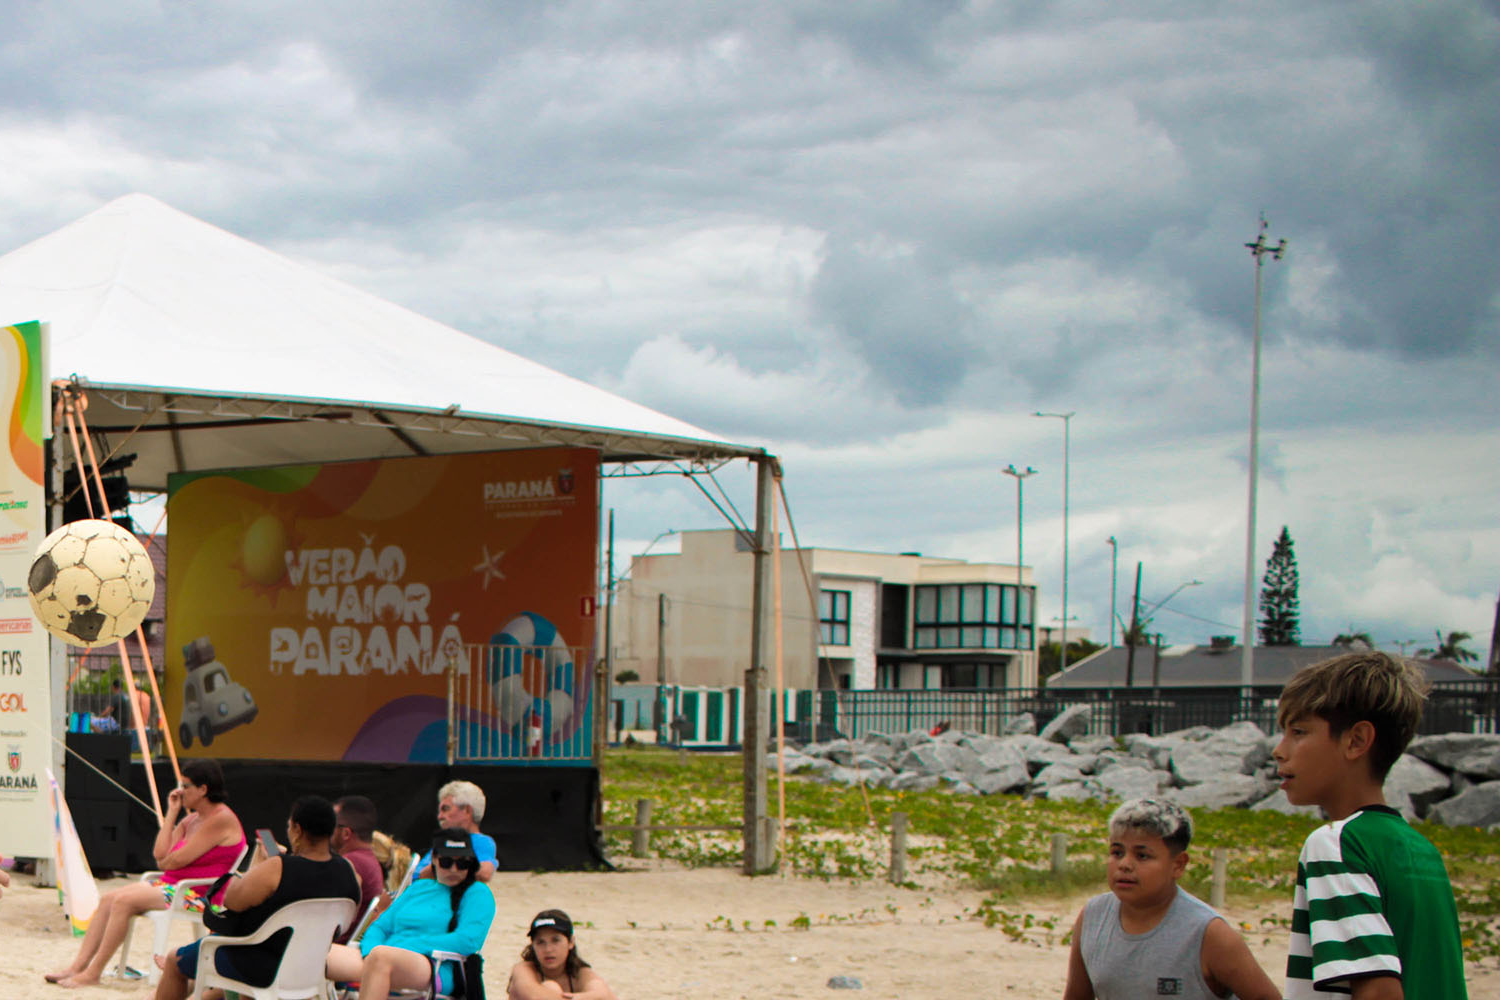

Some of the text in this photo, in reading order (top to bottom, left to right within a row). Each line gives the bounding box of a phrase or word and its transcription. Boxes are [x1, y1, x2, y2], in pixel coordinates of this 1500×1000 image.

[484, 476, 555, 499] PARANÁ
[284, 531, 407, 586] VERÃO
[307, 583, 432, 624] MAIOR
[2, 650, 22, 675] FYS
[270, 612, 471, 676] PARANÁ
